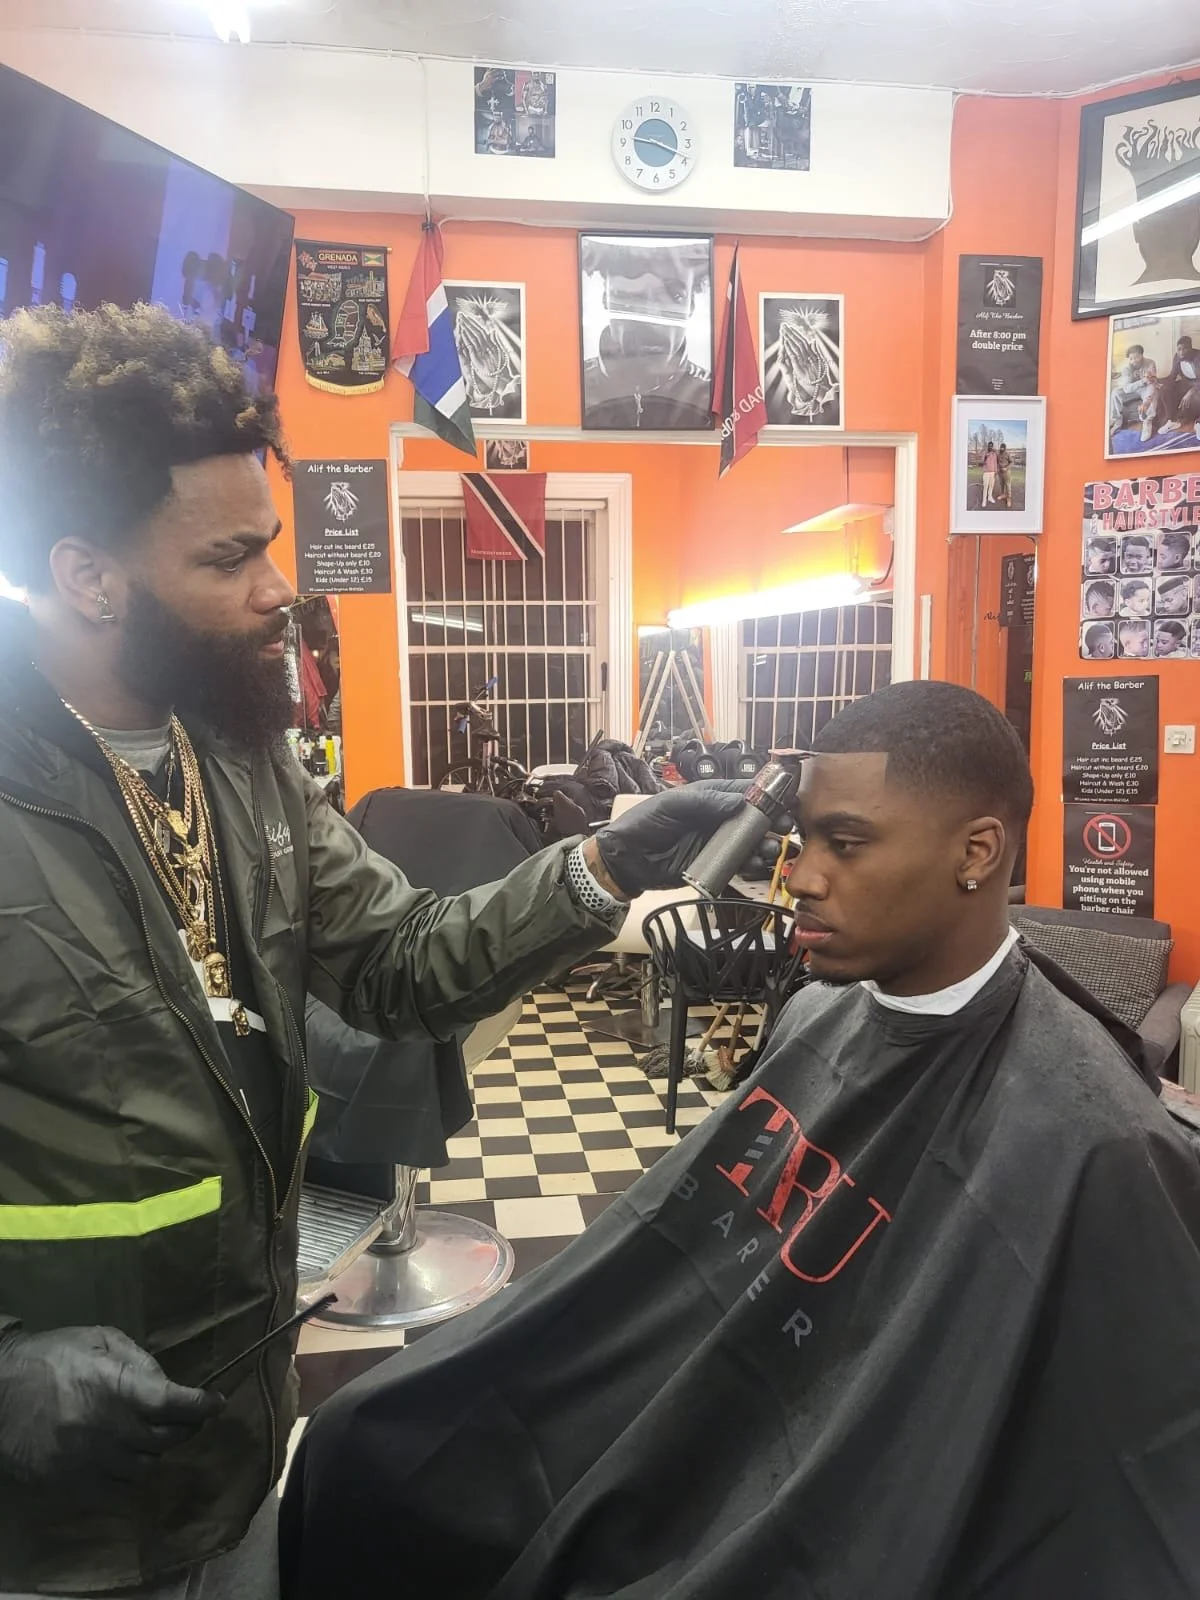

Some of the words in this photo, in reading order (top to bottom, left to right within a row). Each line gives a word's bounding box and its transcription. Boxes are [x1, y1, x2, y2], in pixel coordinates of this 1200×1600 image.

[636, 107, 643, 117] 11
[650, 102, 660, 112] 12
[622, 120, 633, 130] 10
[680, 121, 687, 130] 2
[620, 138, 626, 147] 9
[684, 139, 692, 148] 3
[625, 156, 631, 165] 8
[636, 168, 644, 178] 7
[669, 169, 676, 179] 5
[653, 174, 660, 183] 6
[318, 253, 358, 262] GRENADA
[970, 330, 992, 338] After
[1012, 332, 1026, 342] pm
[972, 341, 1000, 350] double
[1002, 342, 1024, 352] price
[308, 464, 324, 473] Alif
[326, 464, 341, 473] the
[344, 464, 374, 473] Barber
[324, 528, 342, 536] Price
[344, 528, 359, 536] List
[1078, 682, 1094, 690] Alif
[1096, 682, 1112, 690] the
[1114, 681, 1144, 690] Barber
[1092, 742, 1110, 750] Price
[1112, 742, 1126, 750] List
[1068, 865, 1096, 874] You're
[1098, 867, 1112, 875] not
[1114, 867, 1149, 877] allowed
[1081, 876, 1104, 886] using
[1106, 877, 1136, 886] mobile
[1072, 884, 1100, 894] phone
[1101, 886, 1125, 895] when
[1126, 888, 1144, 896] you
[1080, 894, 1107, 905] sitting
[1122, 897, 1136, 906] the
[1081, 904, 1110, 913] barber
[1112, 905, 1135, 915] chair
[716, 1085, 892, 1284] TRU
[672, 1172, 814, 1348] BARER
